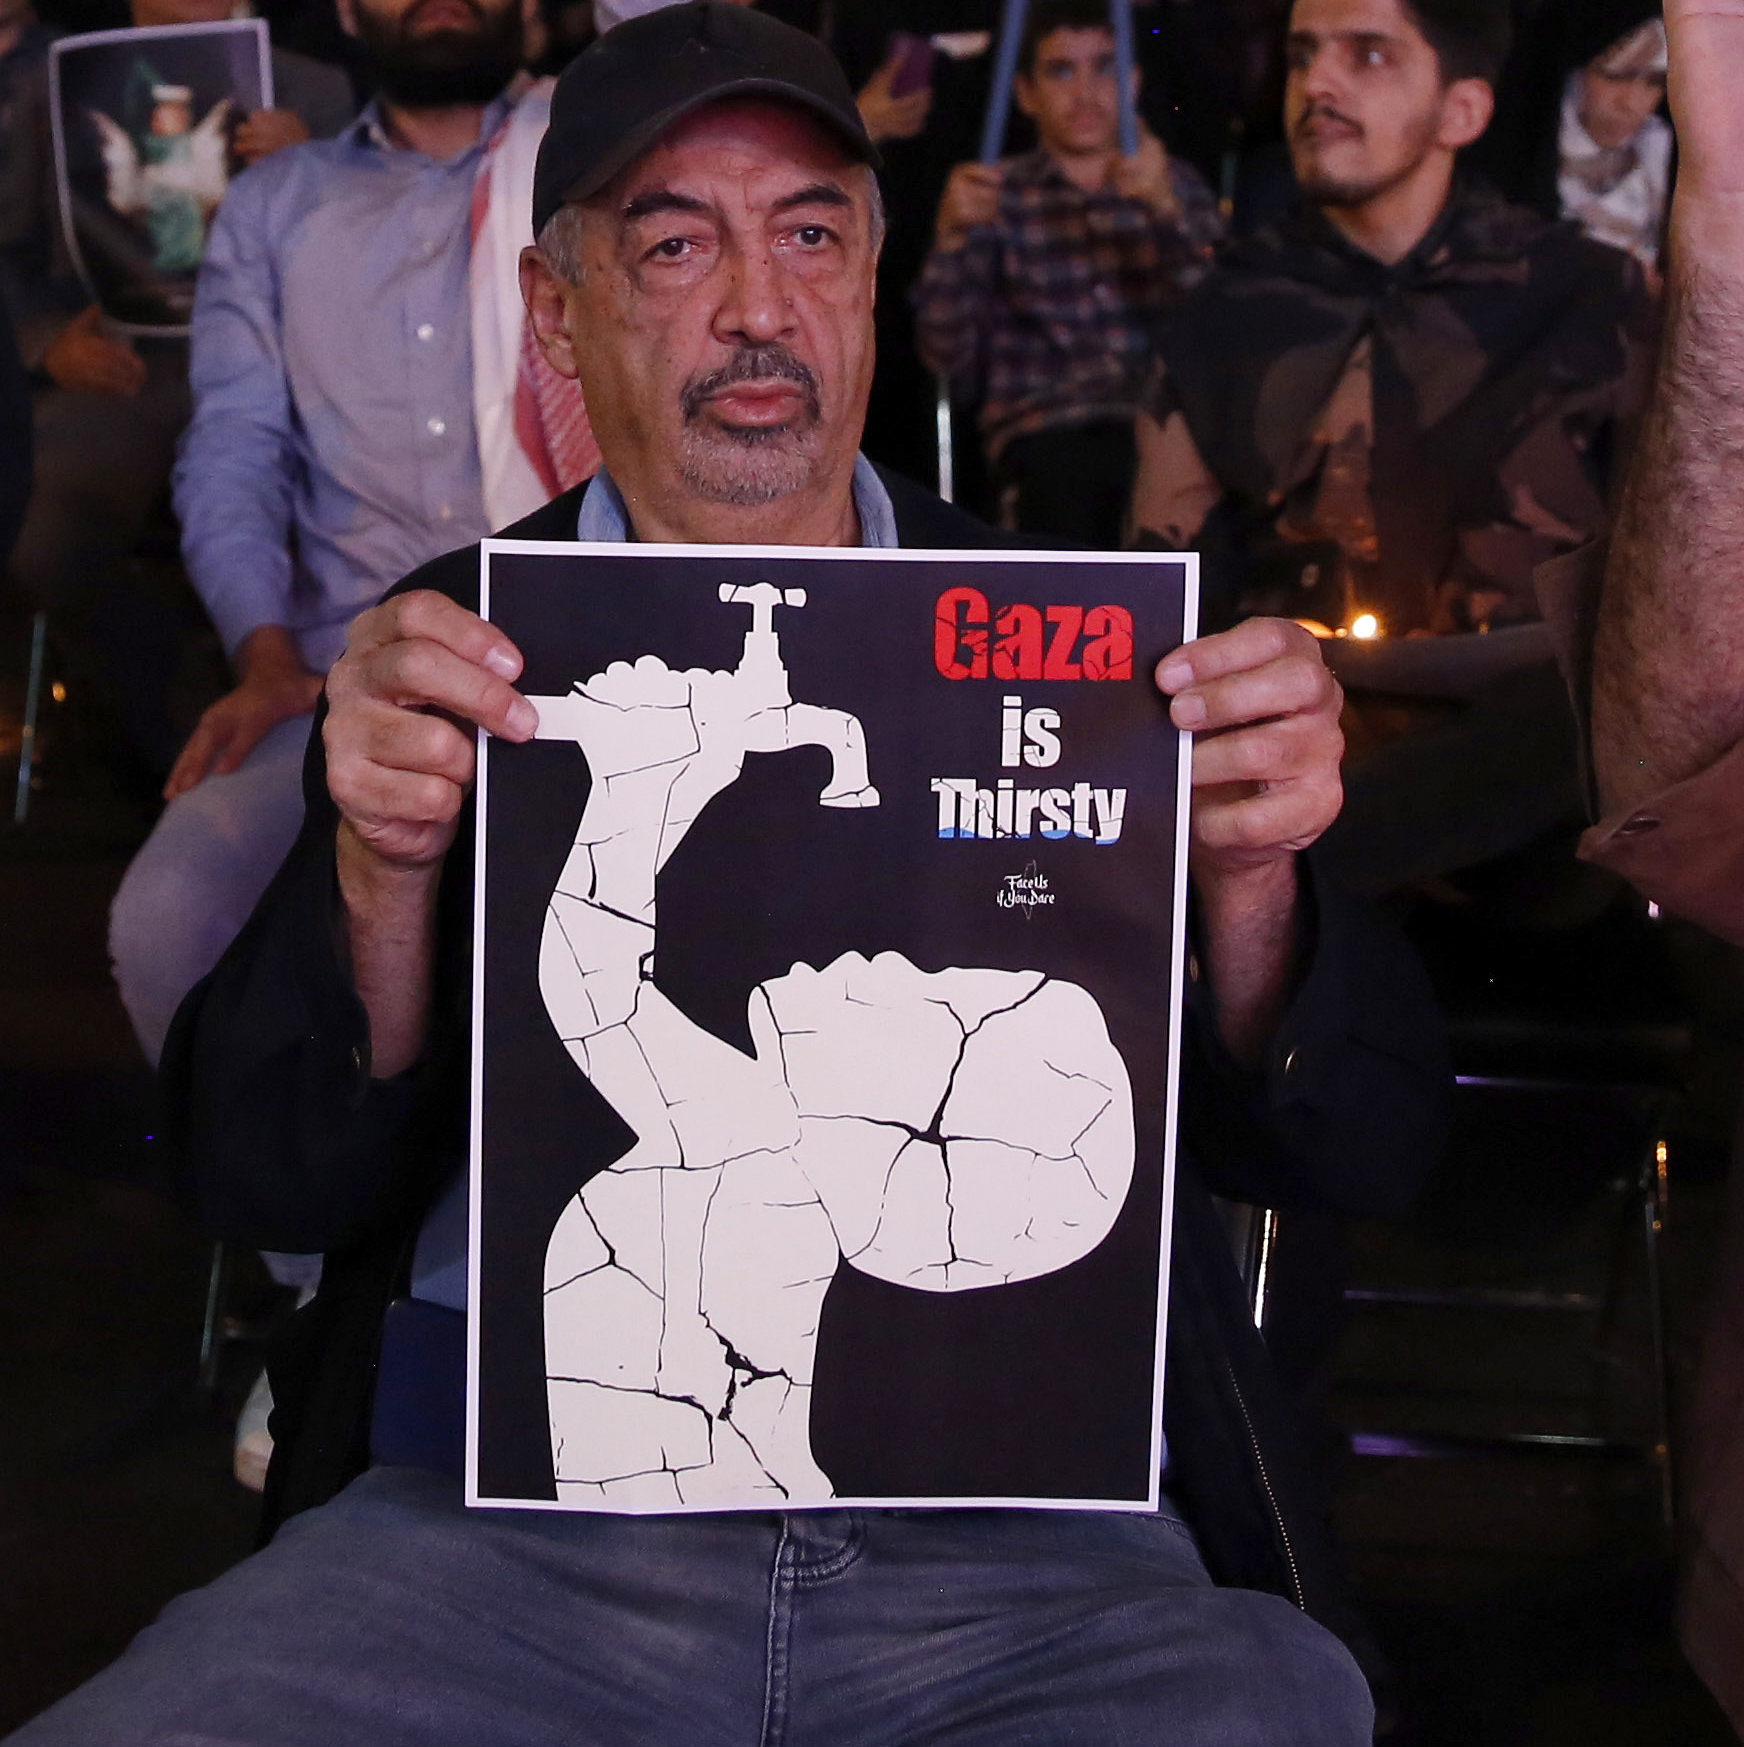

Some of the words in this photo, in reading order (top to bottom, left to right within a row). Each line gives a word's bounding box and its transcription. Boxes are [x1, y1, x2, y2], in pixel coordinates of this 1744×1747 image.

[934, 586, 1134, 681] Gaza
[1001, 695, 1062, 768] is
[931, 778, 1128, 845] Thirsty
[1004, 874, 1033, 890] Face
[1034, 874, 1049, 889] Us
[1004, 889, 1027, 908] You
[1028, 889, 1055, 906] Dare
